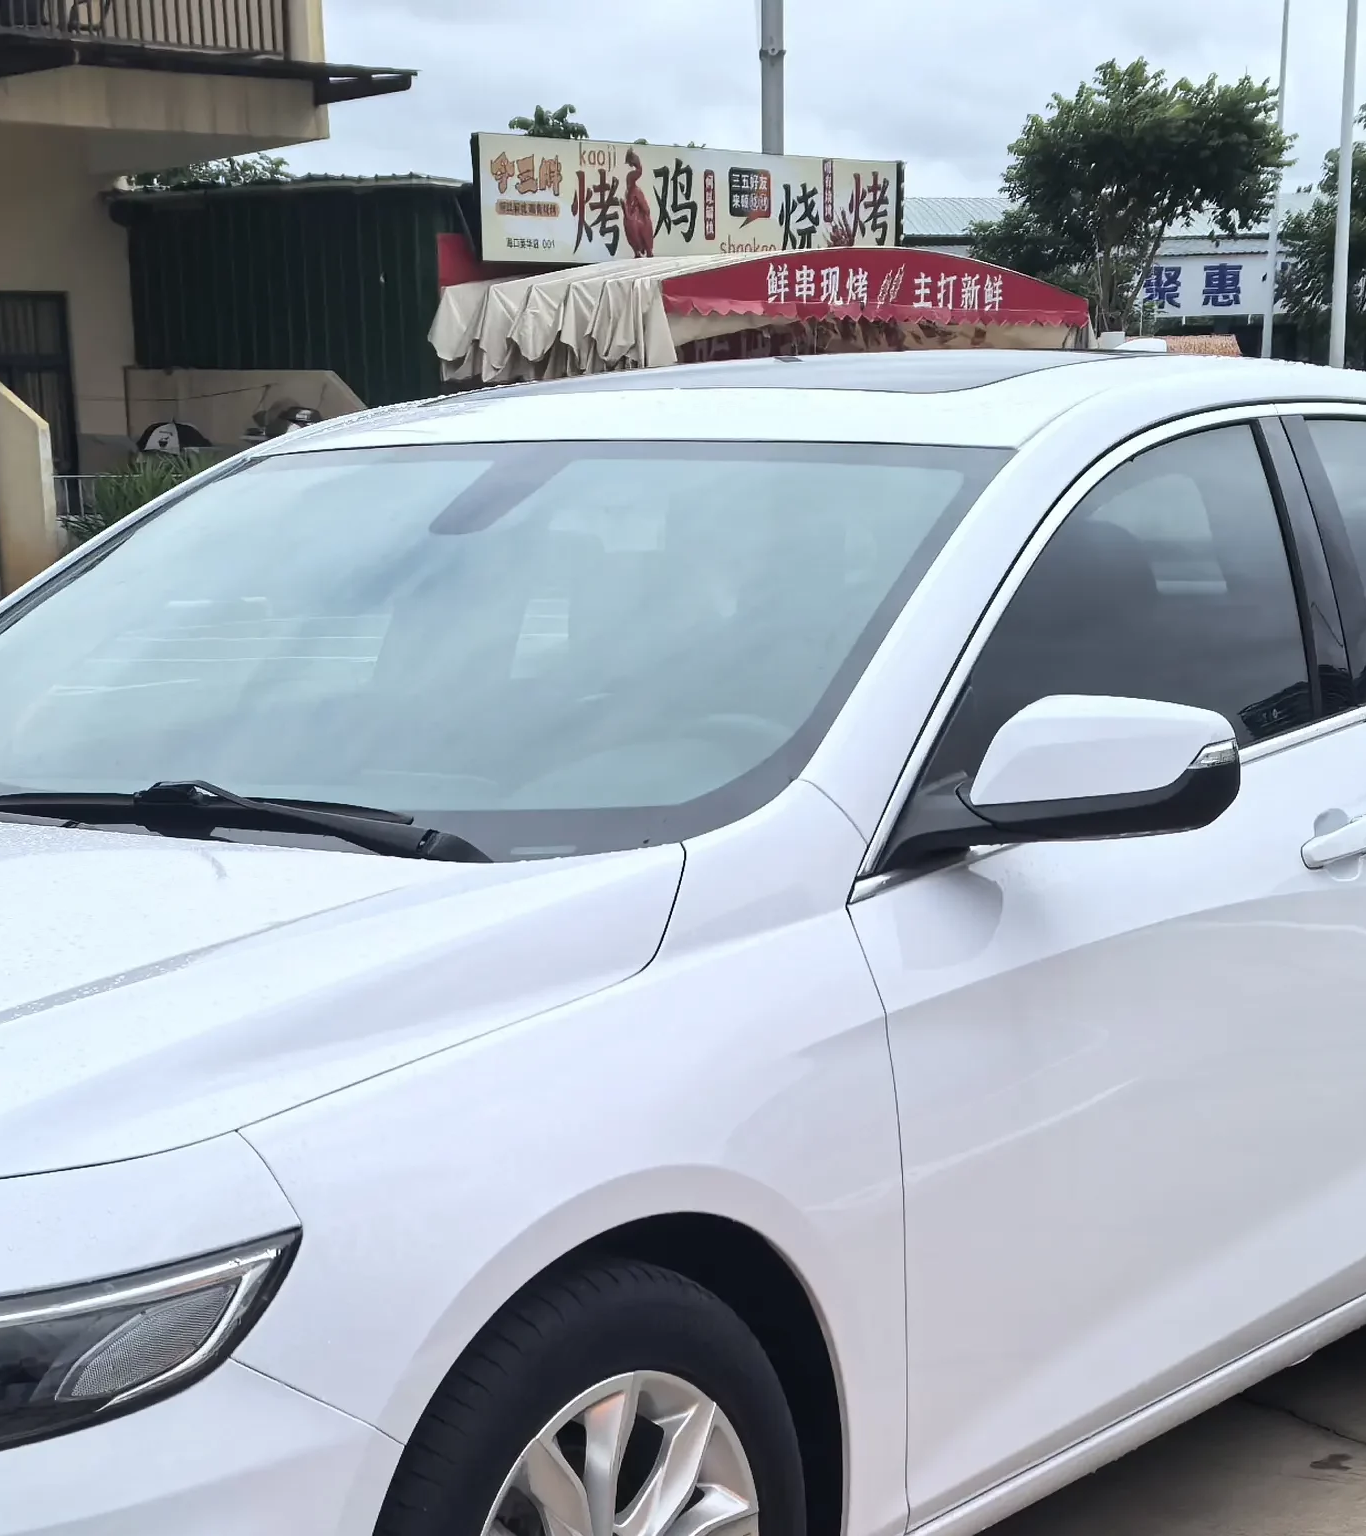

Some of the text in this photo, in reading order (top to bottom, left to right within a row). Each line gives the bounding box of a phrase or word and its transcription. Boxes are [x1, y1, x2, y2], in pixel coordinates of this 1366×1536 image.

[579, 142, 616, 171] kaoji
[731, 173, 768, 191] 三五好友
[571, 157, 698, 256] 烤鸡
[778, 171, 890, 250] 烧烤
[766, 263, 1003, 312] 鲜串现烤 主打新鲜
[1143, 263, 1243, 309] 聚惠
